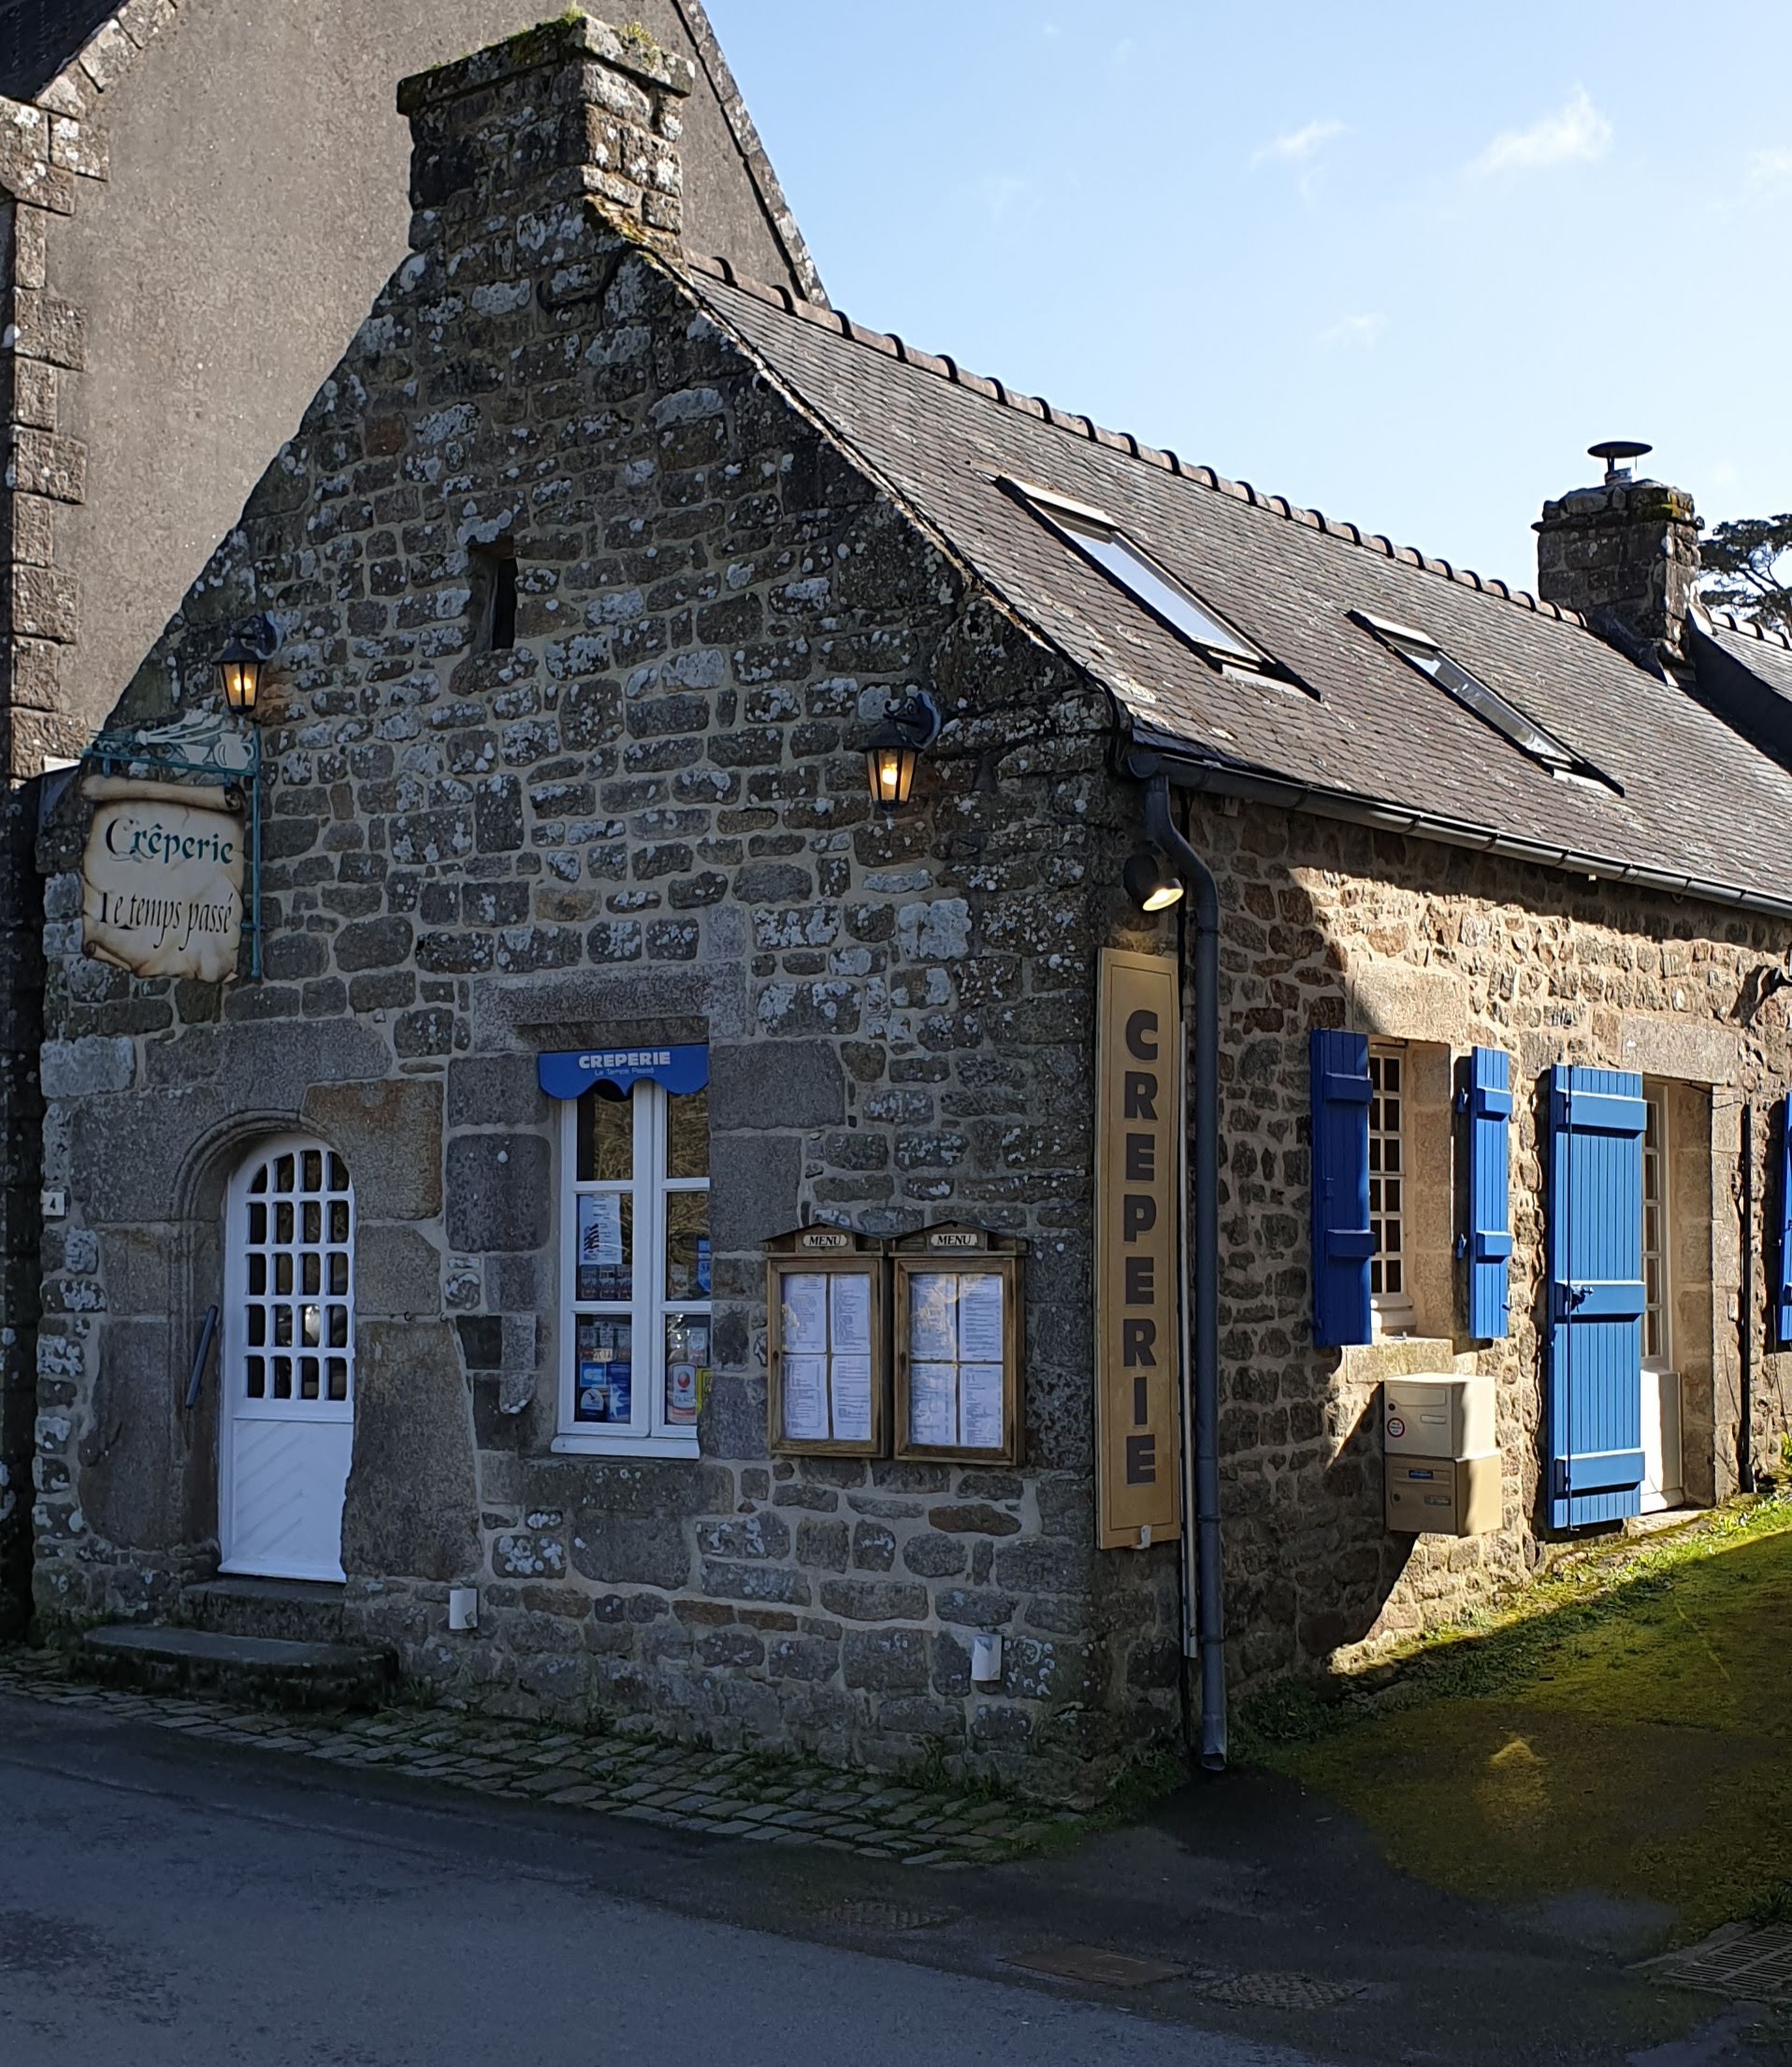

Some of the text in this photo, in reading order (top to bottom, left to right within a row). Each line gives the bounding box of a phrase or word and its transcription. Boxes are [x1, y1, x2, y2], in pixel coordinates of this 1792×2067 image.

[106, 817, 234, 863] Crêperie
[129, 893, 181, 949] temps
[179, 892, 233, 952] passé
[579, 1052, 671, 1069] CREPERIE
[50, 1196, 56, 1210] 4
[809, 1236, 842, 1246] MENU
[936, 1235, 971, 1246] MENU
[1123, 1008, 1159, 1485] CREPERIE
